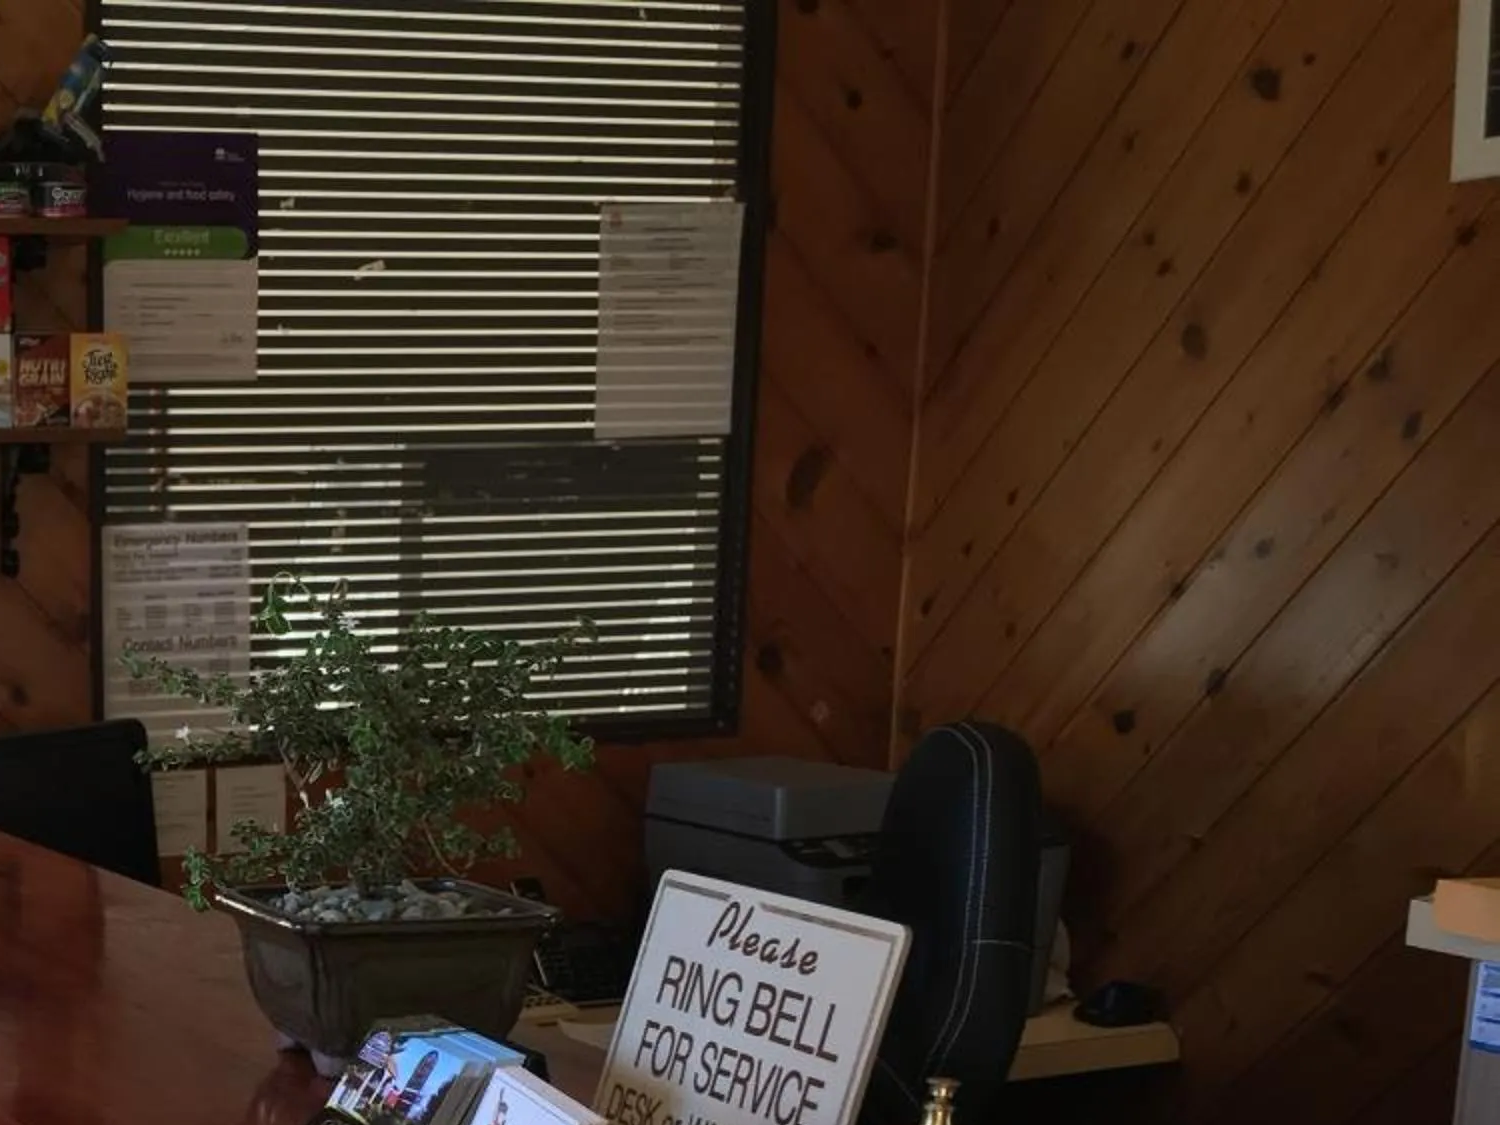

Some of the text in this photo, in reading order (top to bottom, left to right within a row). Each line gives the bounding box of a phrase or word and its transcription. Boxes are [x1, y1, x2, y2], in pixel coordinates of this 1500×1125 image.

[706, 901, 819, 975] Please
[655, 955, 838, 1063] RING BELL
[633, 1019, 695, 1086] FOR
